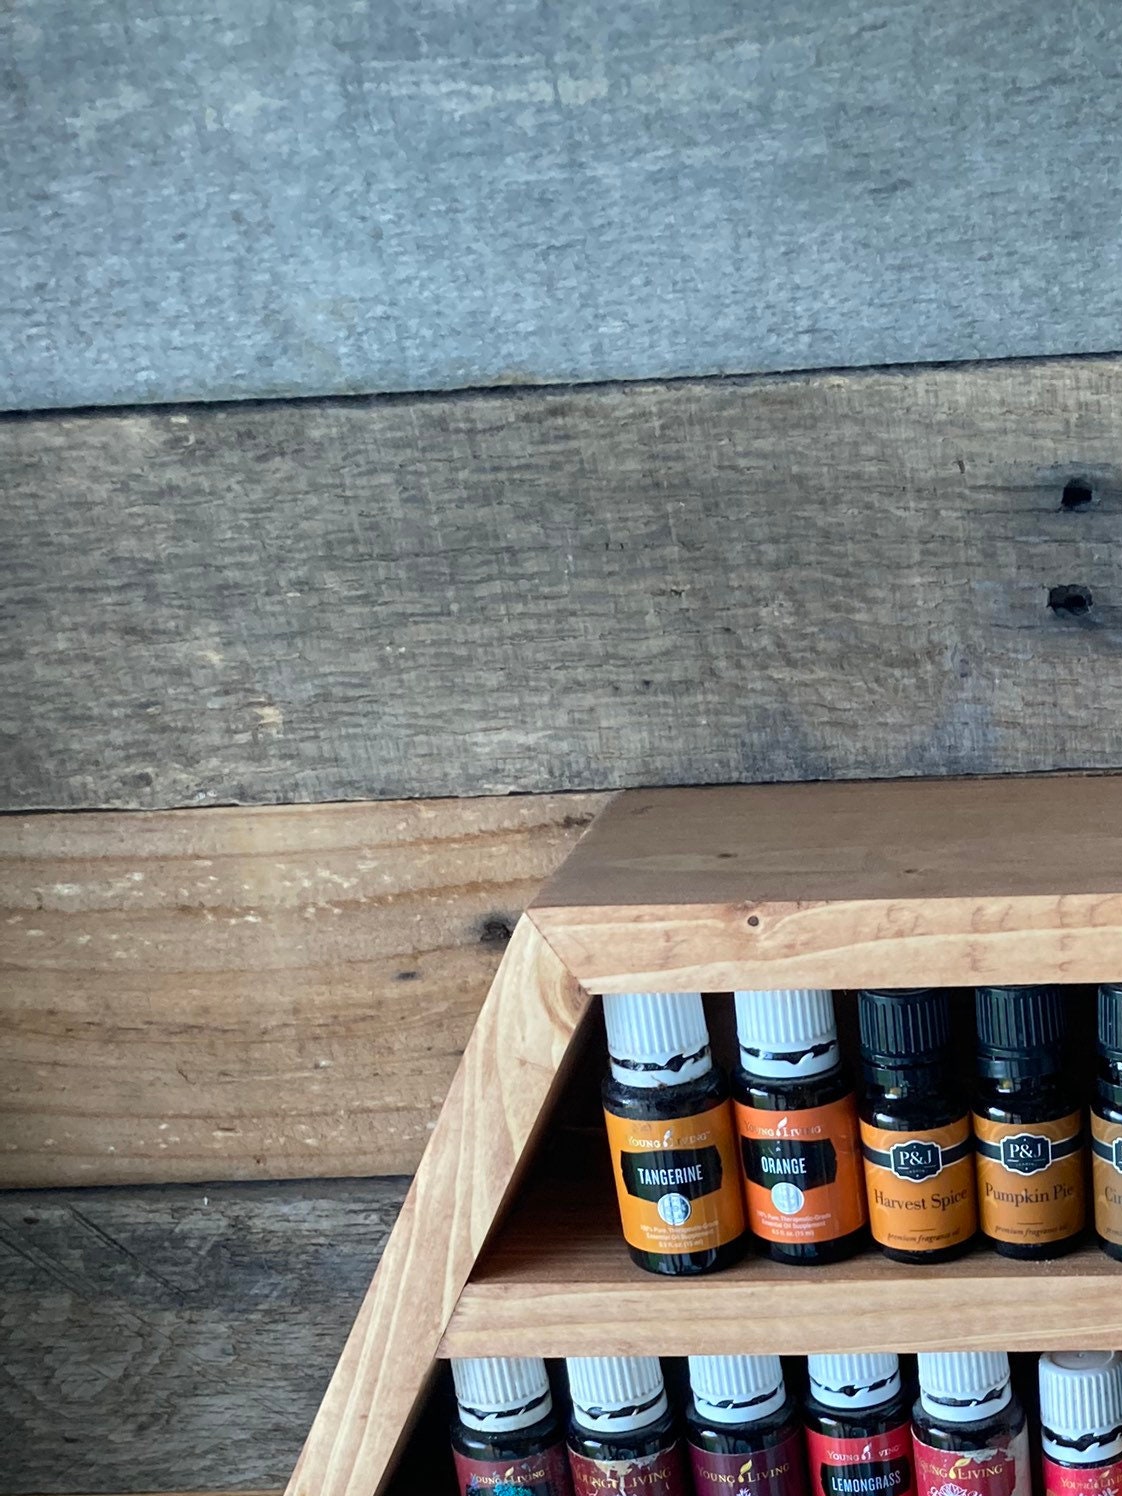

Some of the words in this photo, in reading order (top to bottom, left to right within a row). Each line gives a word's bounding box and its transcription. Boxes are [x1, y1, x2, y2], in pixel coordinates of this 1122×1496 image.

[783, 1125, 822, 1137] LIVING
[899, 1149, 932, 1166] P&J
[1009, 1143, 1041, 1159] P&J
[760, 1156, 807, 1175] ORANGE
[637, 1164, 704, 1186] TANGERINE
[874, 1188, 927, 1211] Harvest
[931, 1188, 968, 1211] Spice
[985, 1182, 1050, 1208] Pumpkin
[1053, 1183, 1074, 1200] Pie
[827, 1450, 860, 1461] YOUNG
[511, 1469, 546, 1483] LIVING
[696, 1464, 736, 1483] YOUNG
[747, 1463, 790, 1482] LIVING
[957, 1464, 1003, 1480] LIVING
[831, 1470, 901, 1493] LEMONGRASS
